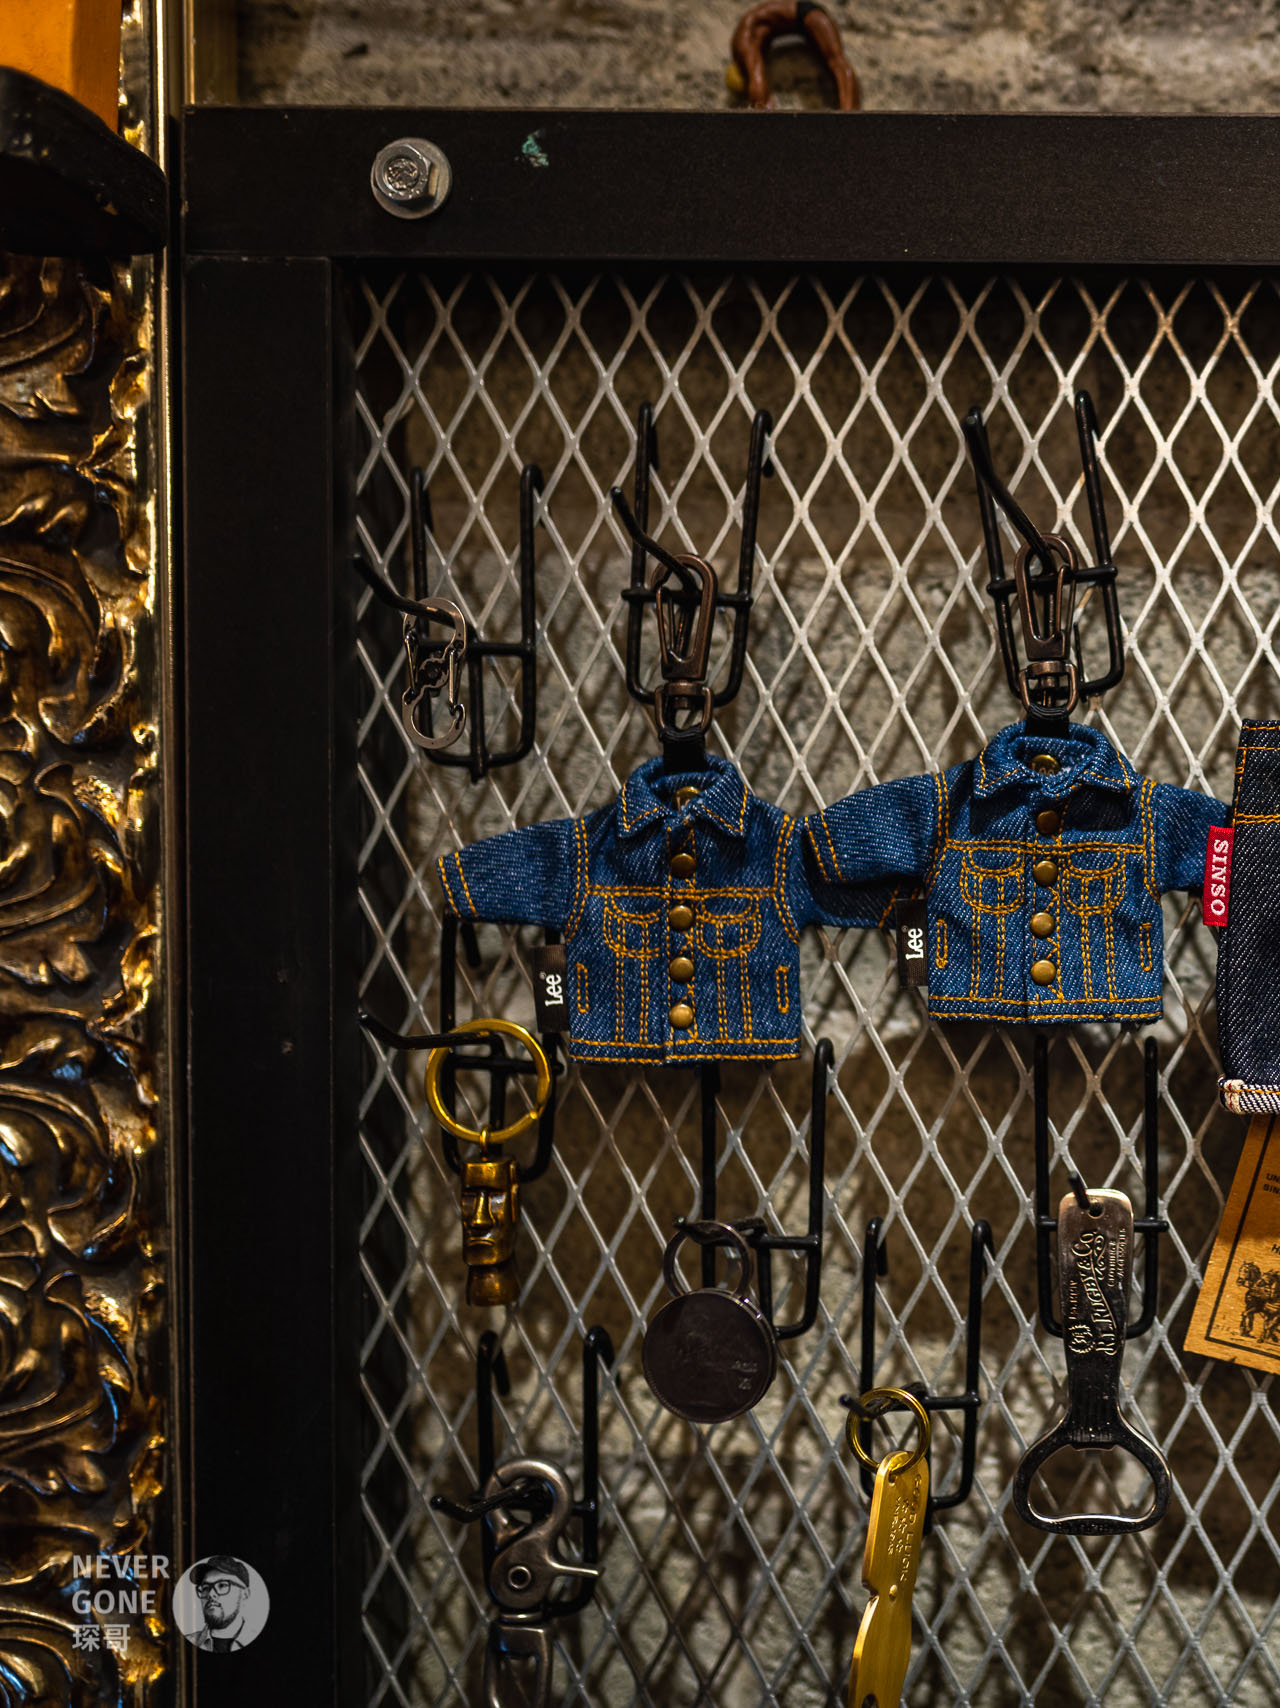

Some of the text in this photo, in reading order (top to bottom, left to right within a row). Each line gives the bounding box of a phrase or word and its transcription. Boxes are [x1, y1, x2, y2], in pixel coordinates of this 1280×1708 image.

[1210, 839, 1229, 916] SINSO
[905, 928, 924, 960] Lee
[544, 973, 563, 1007] Lee
